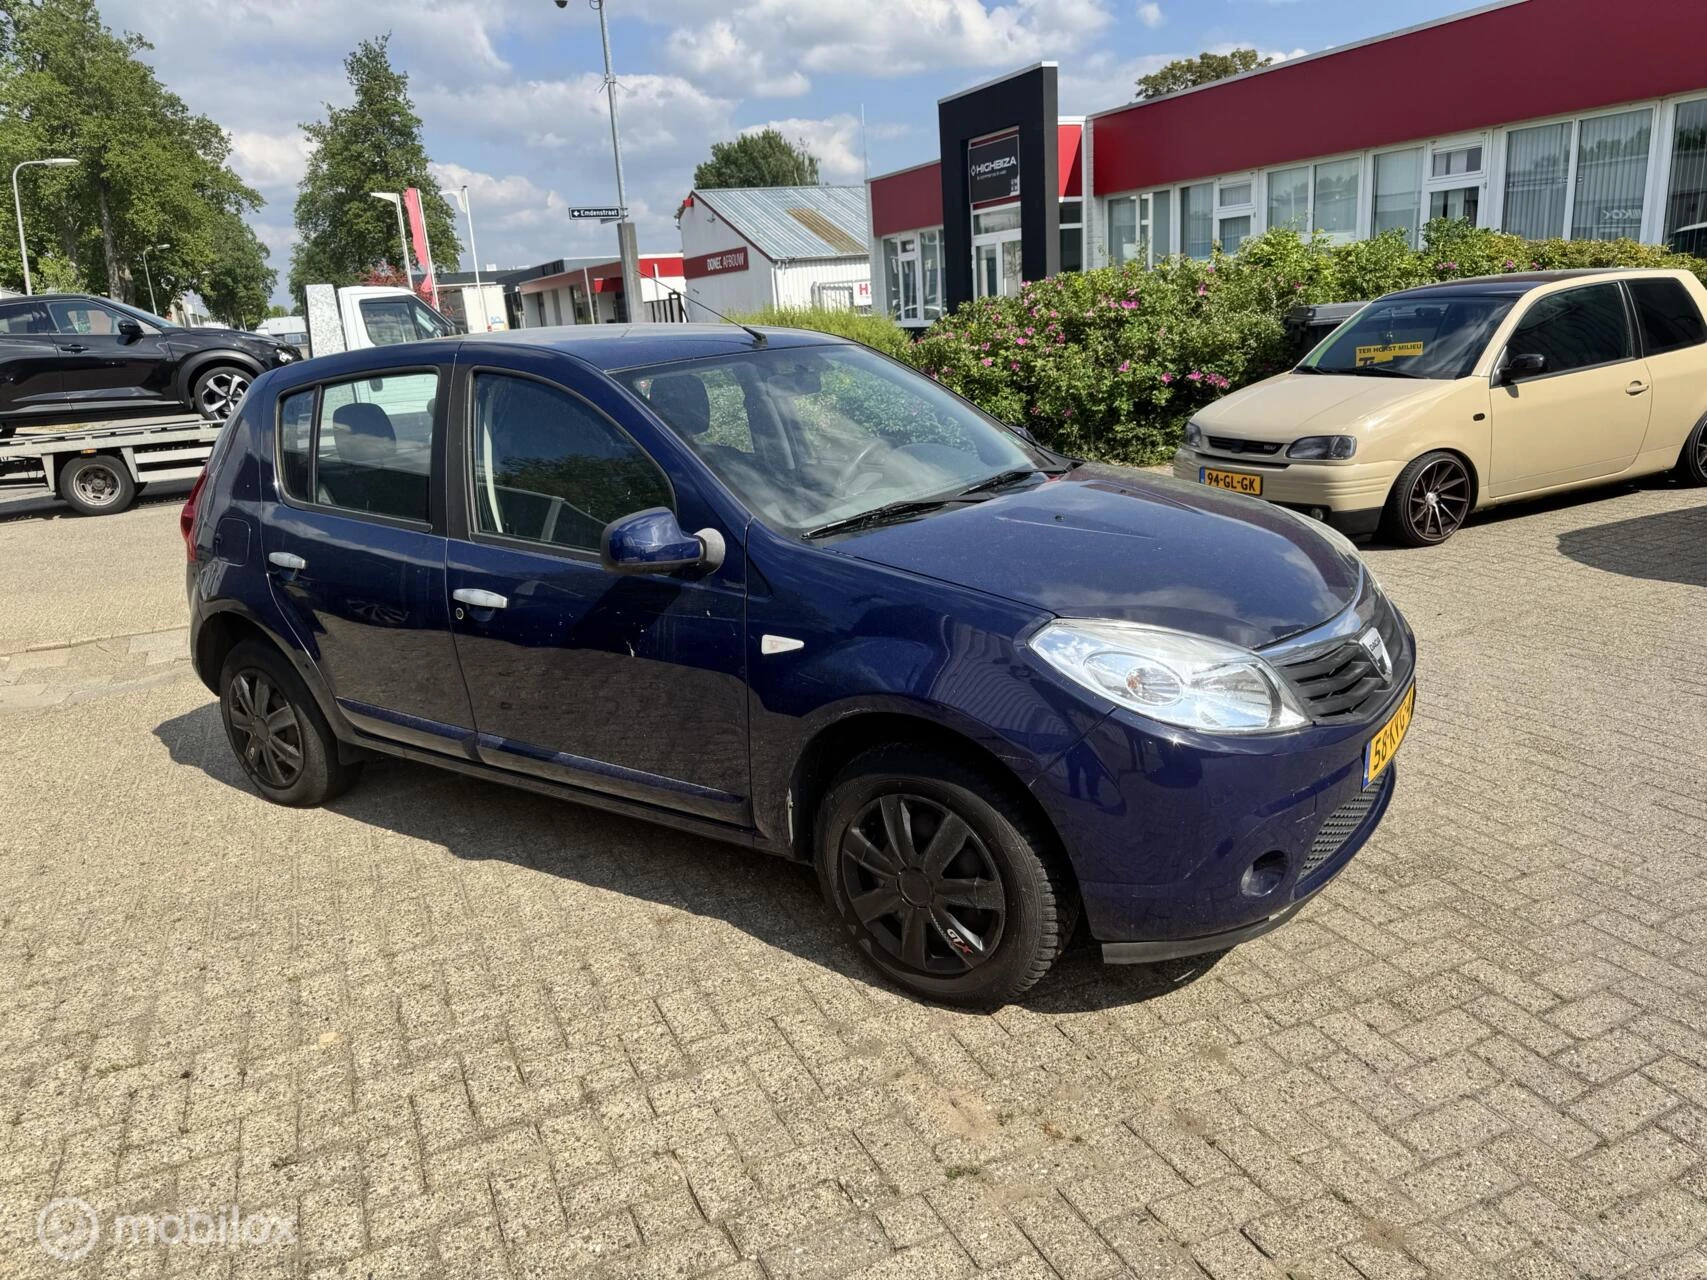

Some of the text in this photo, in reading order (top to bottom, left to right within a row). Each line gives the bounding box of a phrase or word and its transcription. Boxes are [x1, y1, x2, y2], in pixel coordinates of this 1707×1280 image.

[580, 209, 618, 217] Emdenstraat
[1207, 472, 1256, 492] 94-GL-GK
[947, 928, 974, 954] GTX
